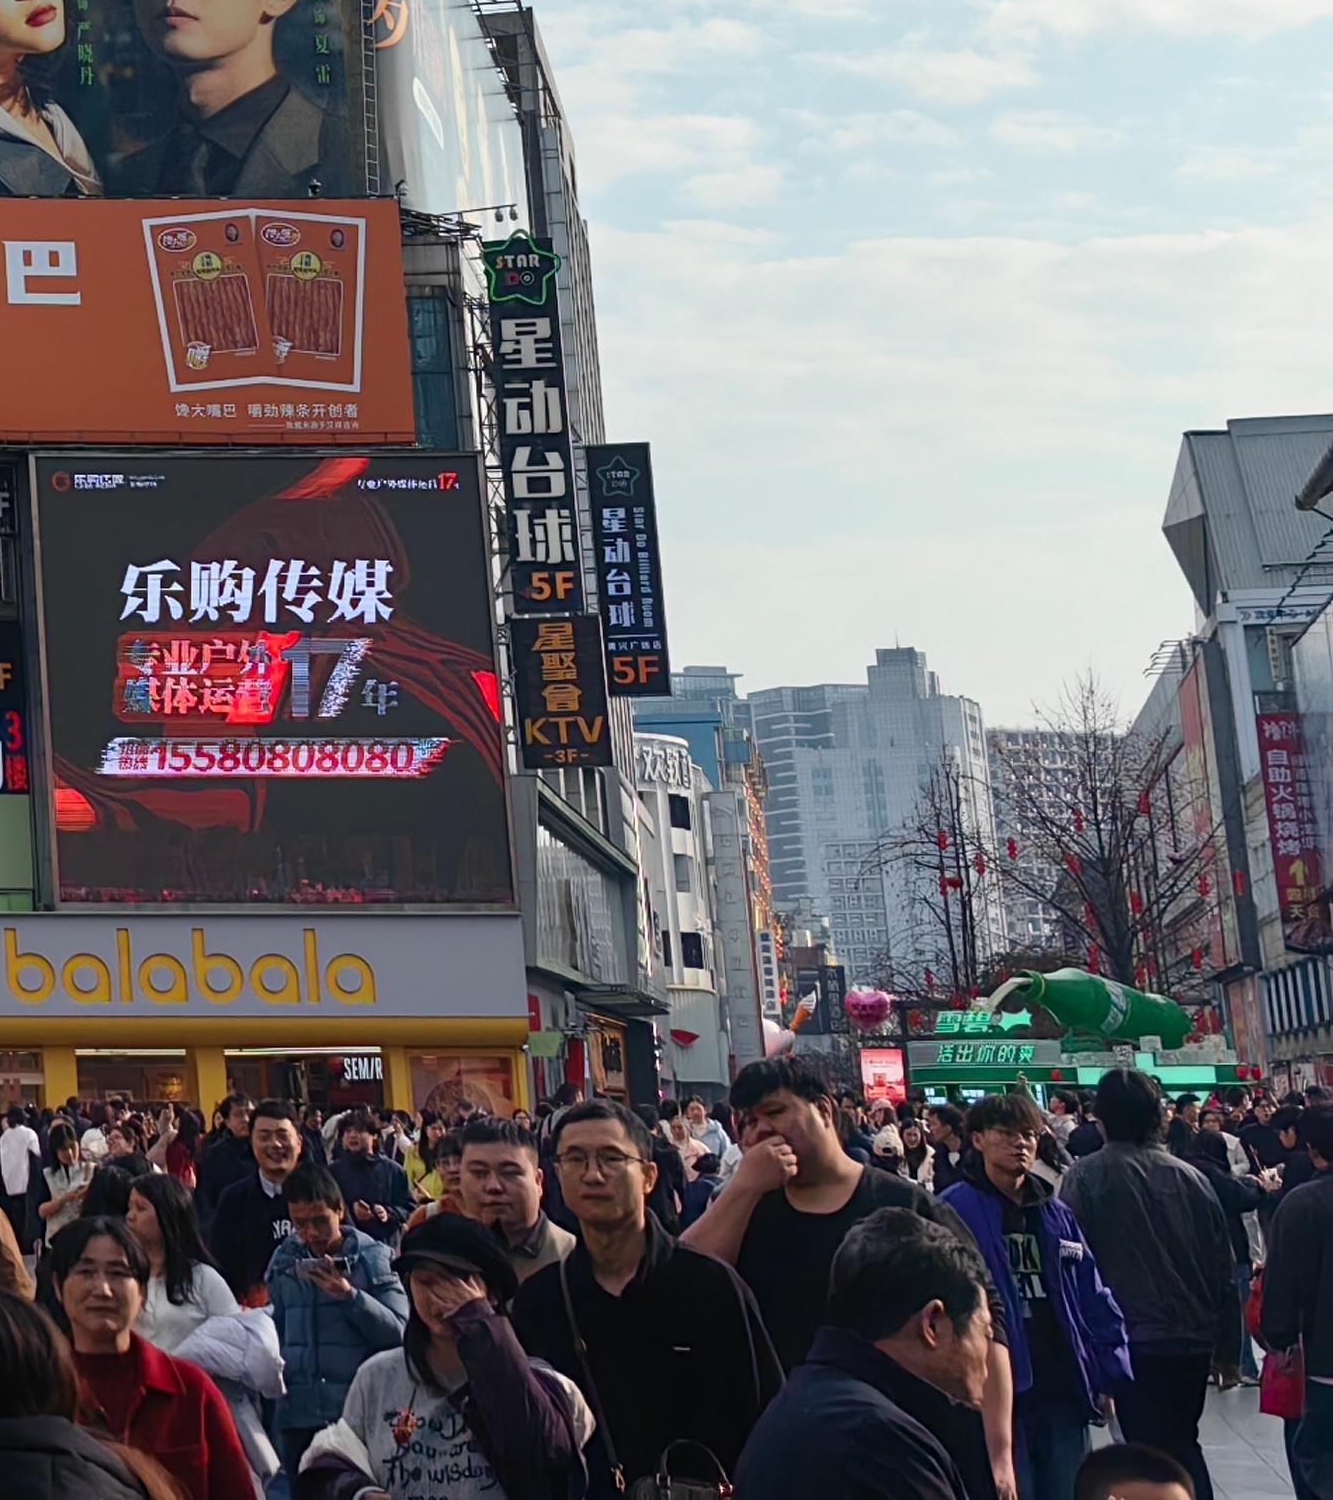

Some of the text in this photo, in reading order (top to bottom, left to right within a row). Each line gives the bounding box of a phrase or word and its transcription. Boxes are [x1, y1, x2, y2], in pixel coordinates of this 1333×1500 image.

[498, 317, 576, 565] 星动台球
[119, 559, 394, 624] 乐购传媒
[530, 571, 575, 600] 5F
[602, 508, 635, 628] 星动台球
[283, 637, 398, 717] 17 年
[532, 622, 581, 713] 星聚會
[612, 656, 661, 684] 5F
[156, 741, 415, 772] 15580808080
[525, 716, 604, 746] KTV
[4, 928, 376, 1003] balabala
[937, 1044, 1036, 1063] 活出你的爽
